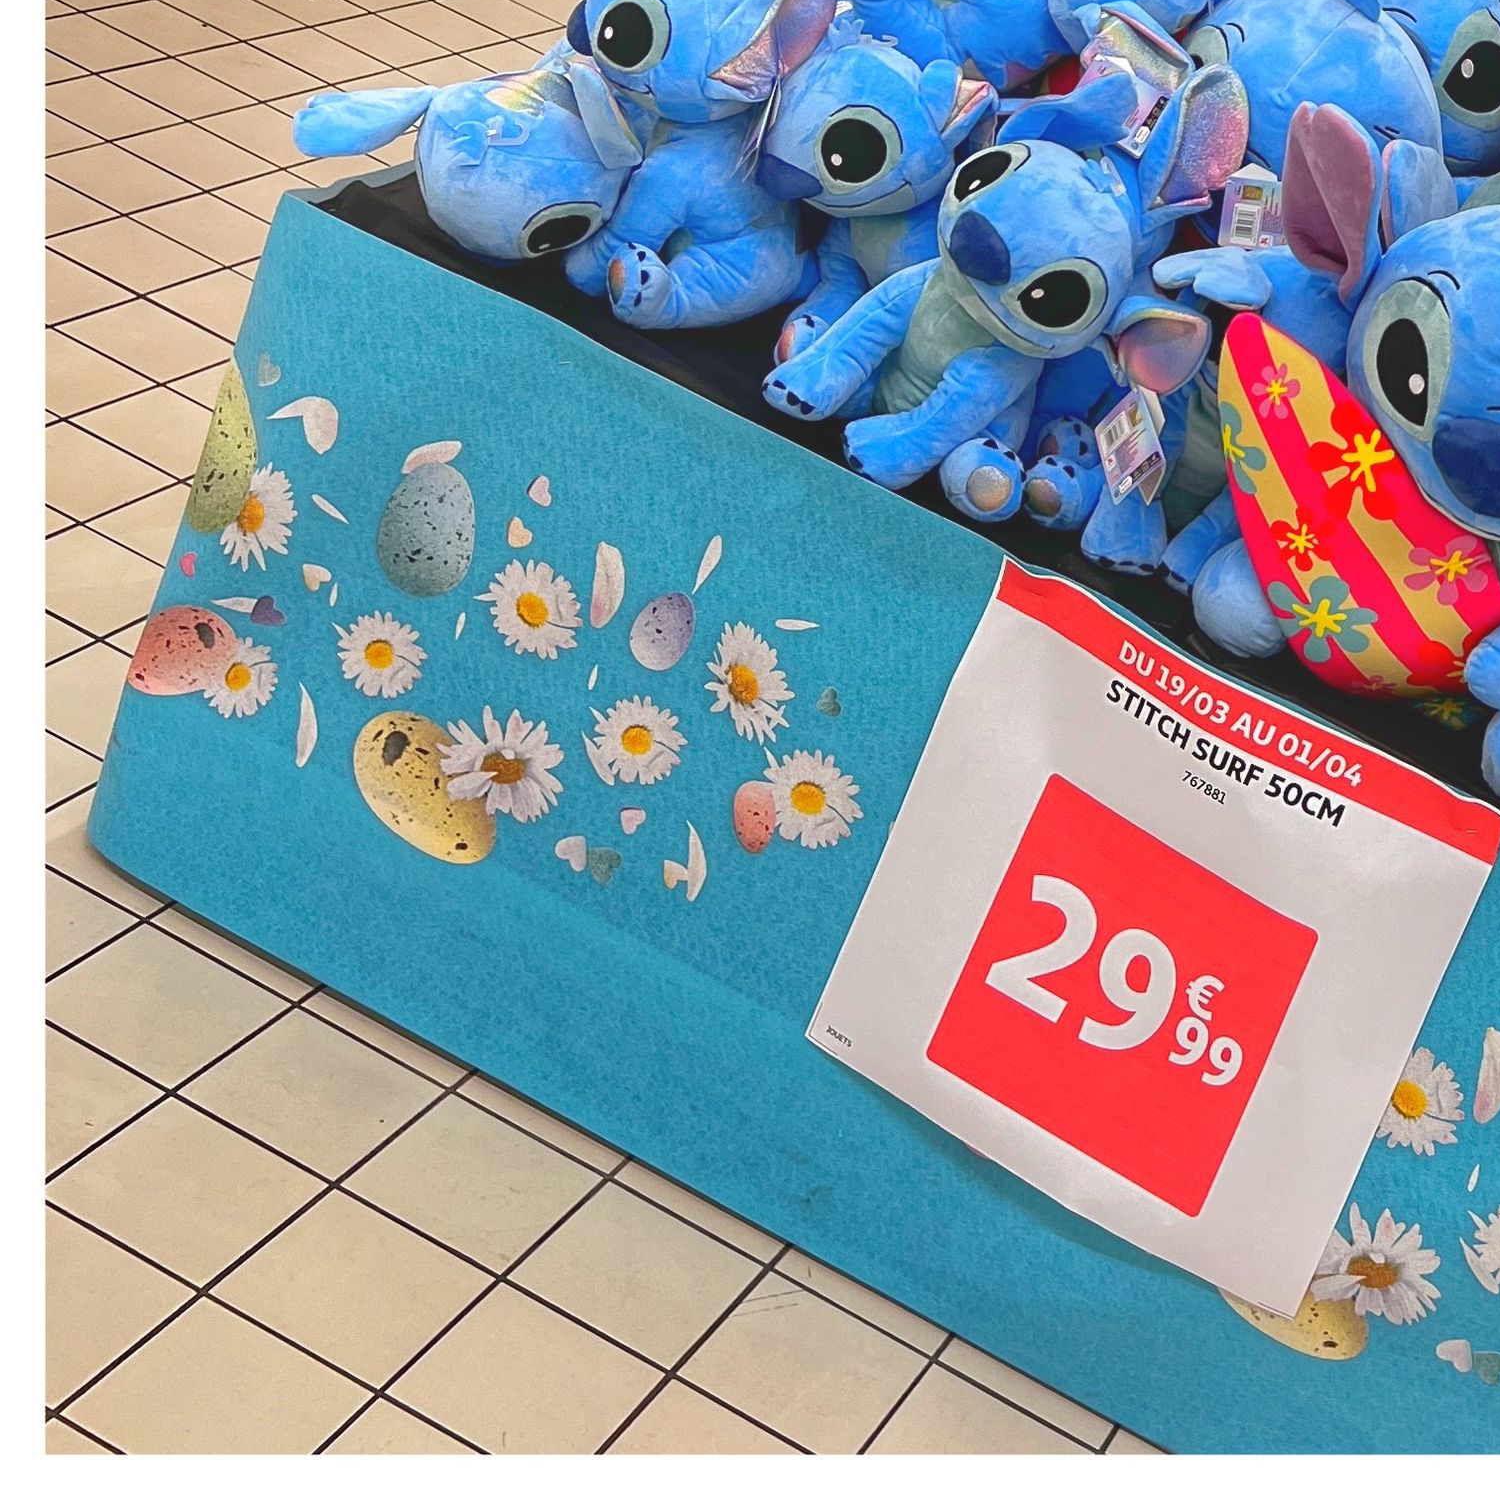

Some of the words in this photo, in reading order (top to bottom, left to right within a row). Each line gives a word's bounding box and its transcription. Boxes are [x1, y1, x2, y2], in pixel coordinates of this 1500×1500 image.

[1106, 680, 1191, 750] STITCH
[1192, 738, 1265, 787] SURF
[1264, 774, 1346, 828] 50CM
[1119, 640, 1155, 677] DU
[1155, 665, 1231, 724] 19/03
[1230, 712, 1277, 746] AU
[1278, 733, 1363, 787] 01/04
[1182, 771, 1227, 805] 767881
